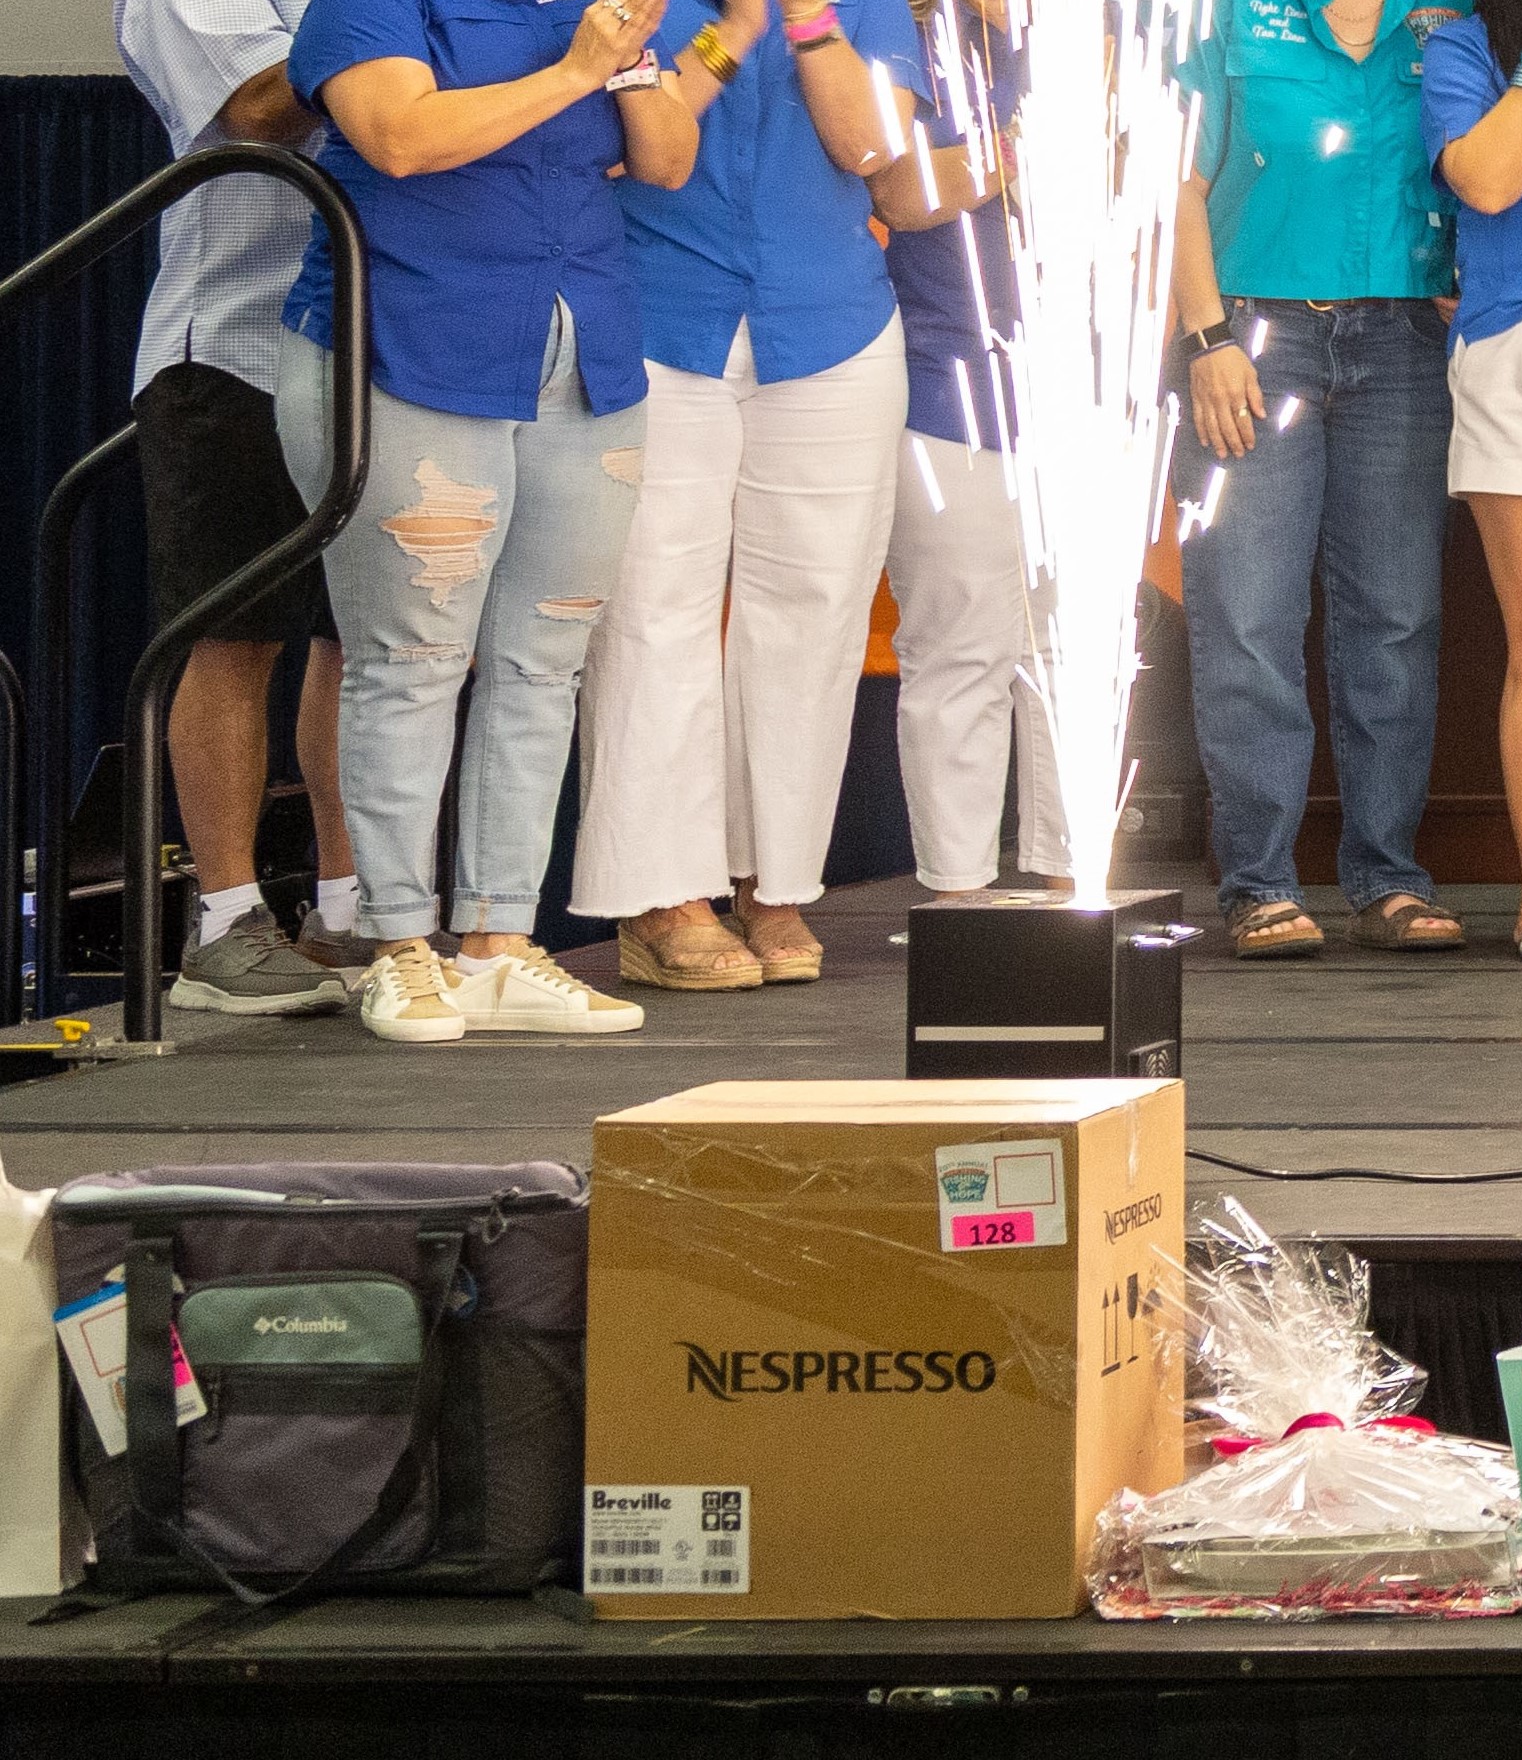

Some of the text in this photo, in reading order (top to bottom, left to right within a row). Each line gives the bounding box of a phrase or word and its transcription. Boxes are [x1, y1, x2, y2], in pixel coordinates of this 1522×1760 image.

[1103, 1192, 1163, 1246] NESPRESSO
[969, 1221, 1017, 1247] 128
[271, 1316, 347, 1334] Columbia
[674, 1341, 996, 1403] NESPRESSO
[591, 1490, 672, 1511] Breville
